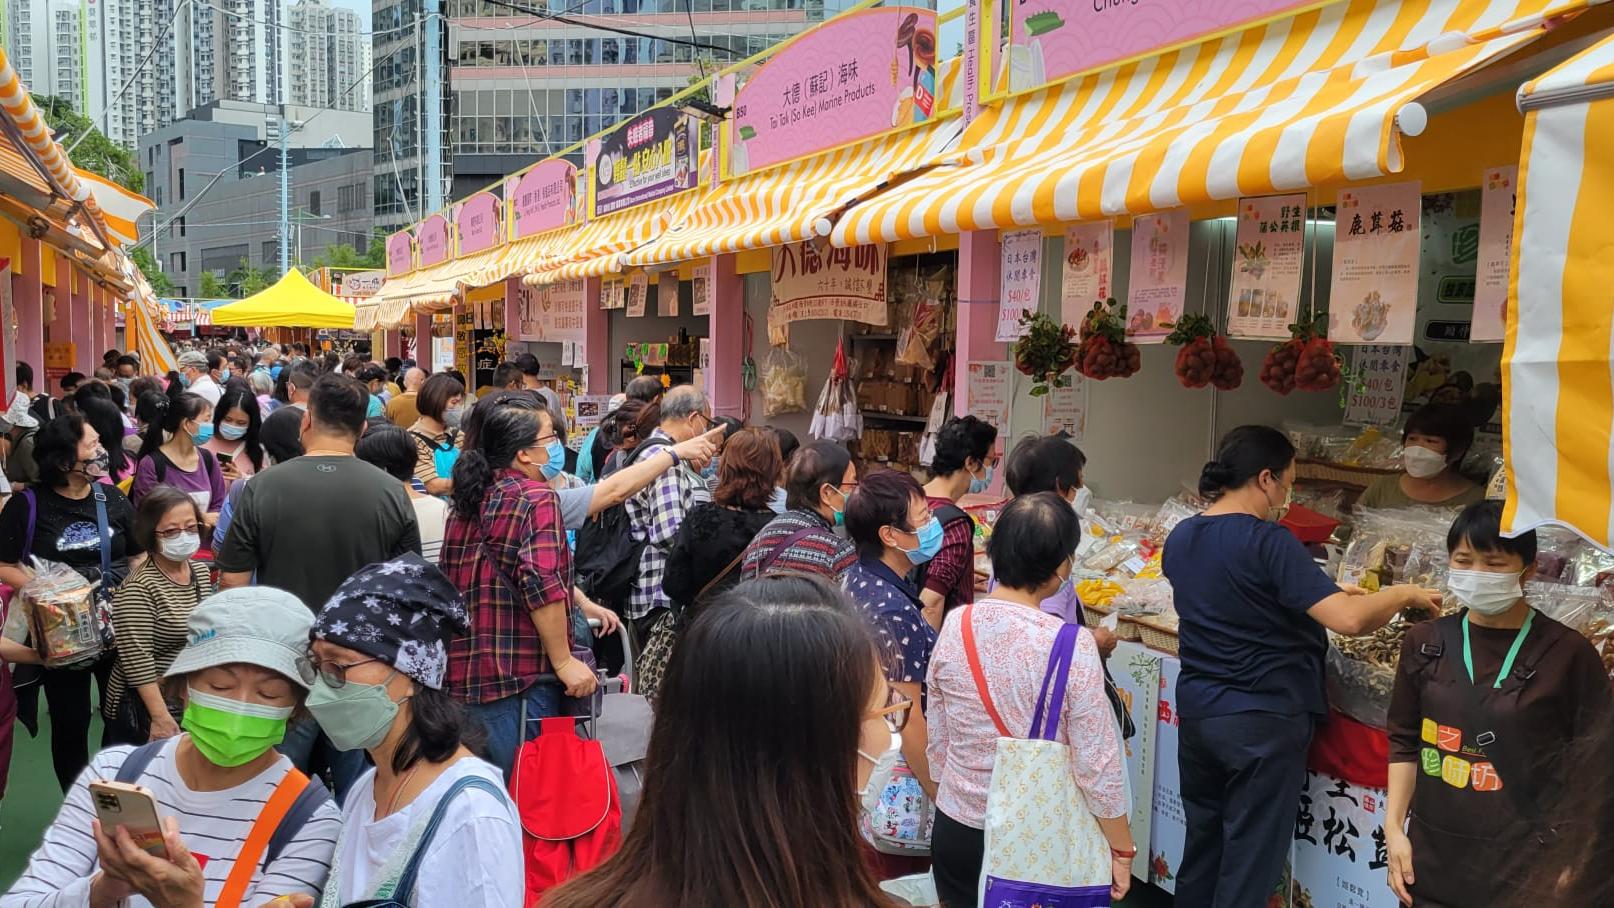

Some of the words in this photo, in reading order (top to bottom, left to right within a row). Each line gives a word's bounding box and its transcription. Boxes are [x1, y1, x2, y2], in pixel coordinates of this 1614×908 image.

[736, 105, 747, 119] B50
[769, 115, 778, 129] Tai
[779, 111, 790, 127] Tak
[802, 104, 817, 121] Kee)
[818, 95, 843, 113] Marine
[844, 81, 876, 104] Products
[1281, 204, 1301, 218] 野生
[1348, 209, 1404, 236] 鹿茸菇
